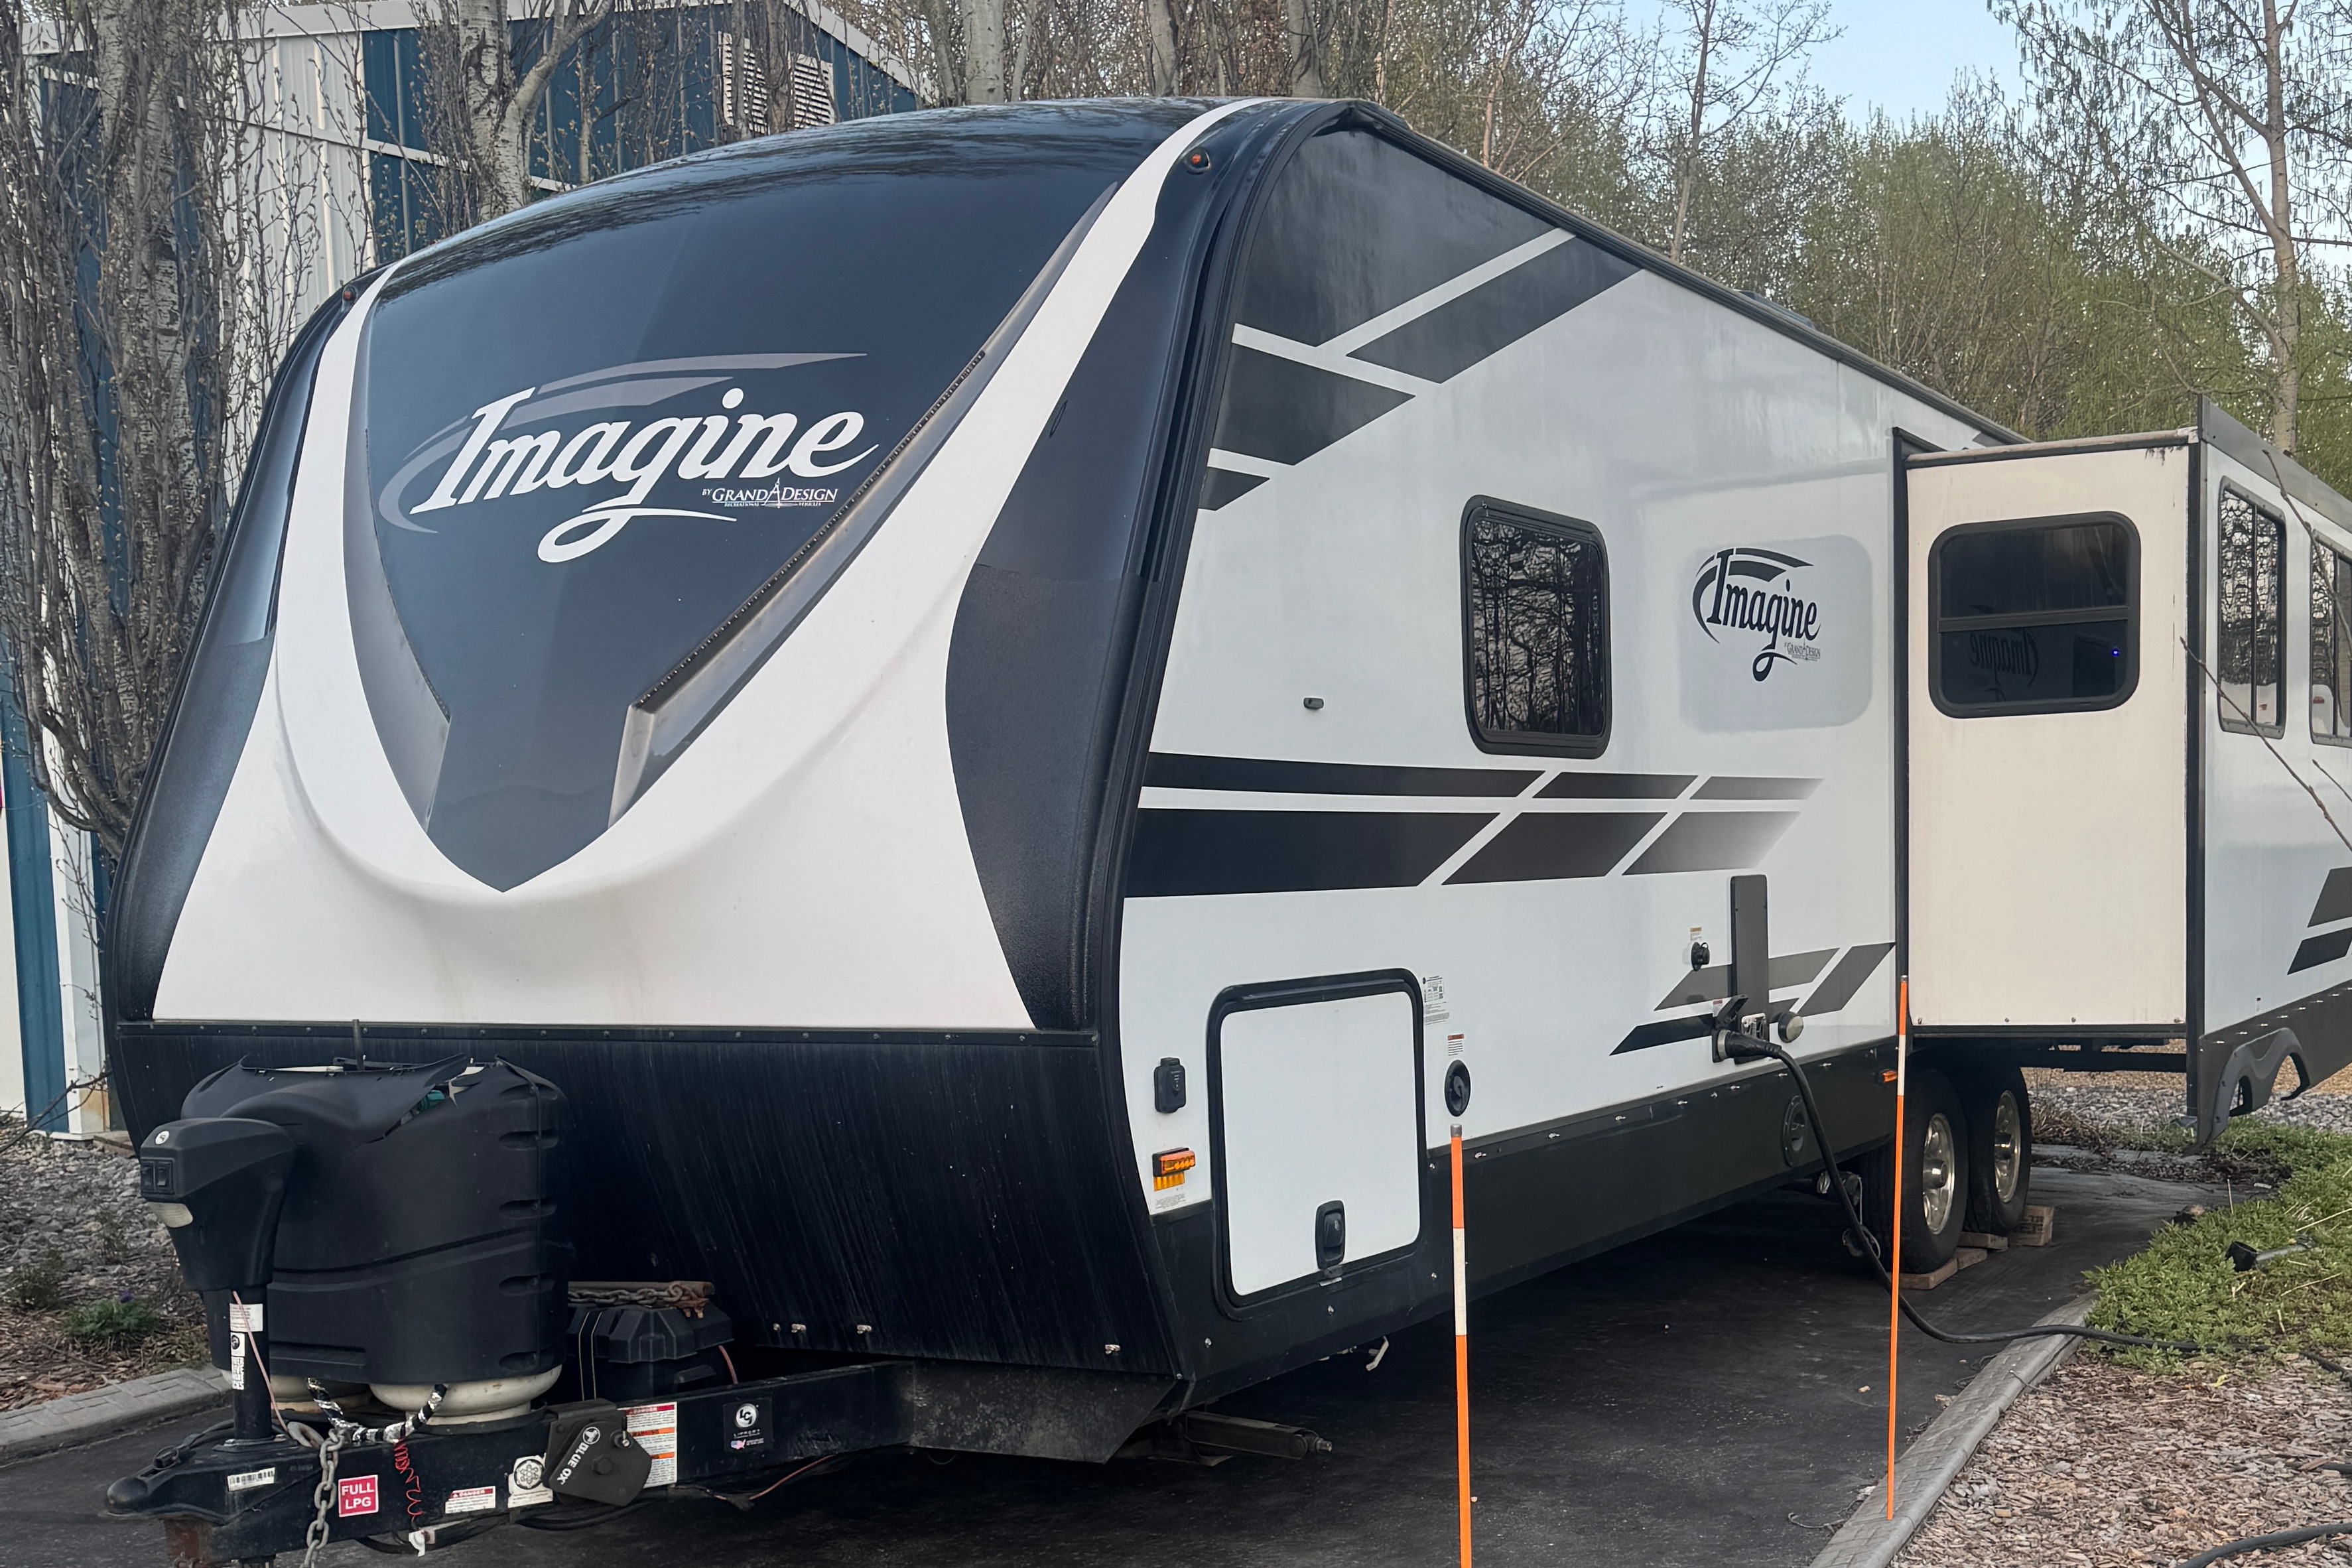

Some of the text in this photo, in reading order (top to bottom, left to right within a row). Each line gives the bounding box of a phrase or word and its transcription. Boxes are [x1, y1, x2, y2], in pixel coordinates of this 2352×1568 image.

[409, 387, 880, 563] Imagine
[712, 488, 767, 501] GRAND
[781, 487, 838, 501] DESIGN
[1707, 548, 1821, 682] Imagine
[557, 1442, 589, 1485] BLUE OX
[342, 1482, 375, 1496] FULL
[345, 1496, 372, 1510] LPG
